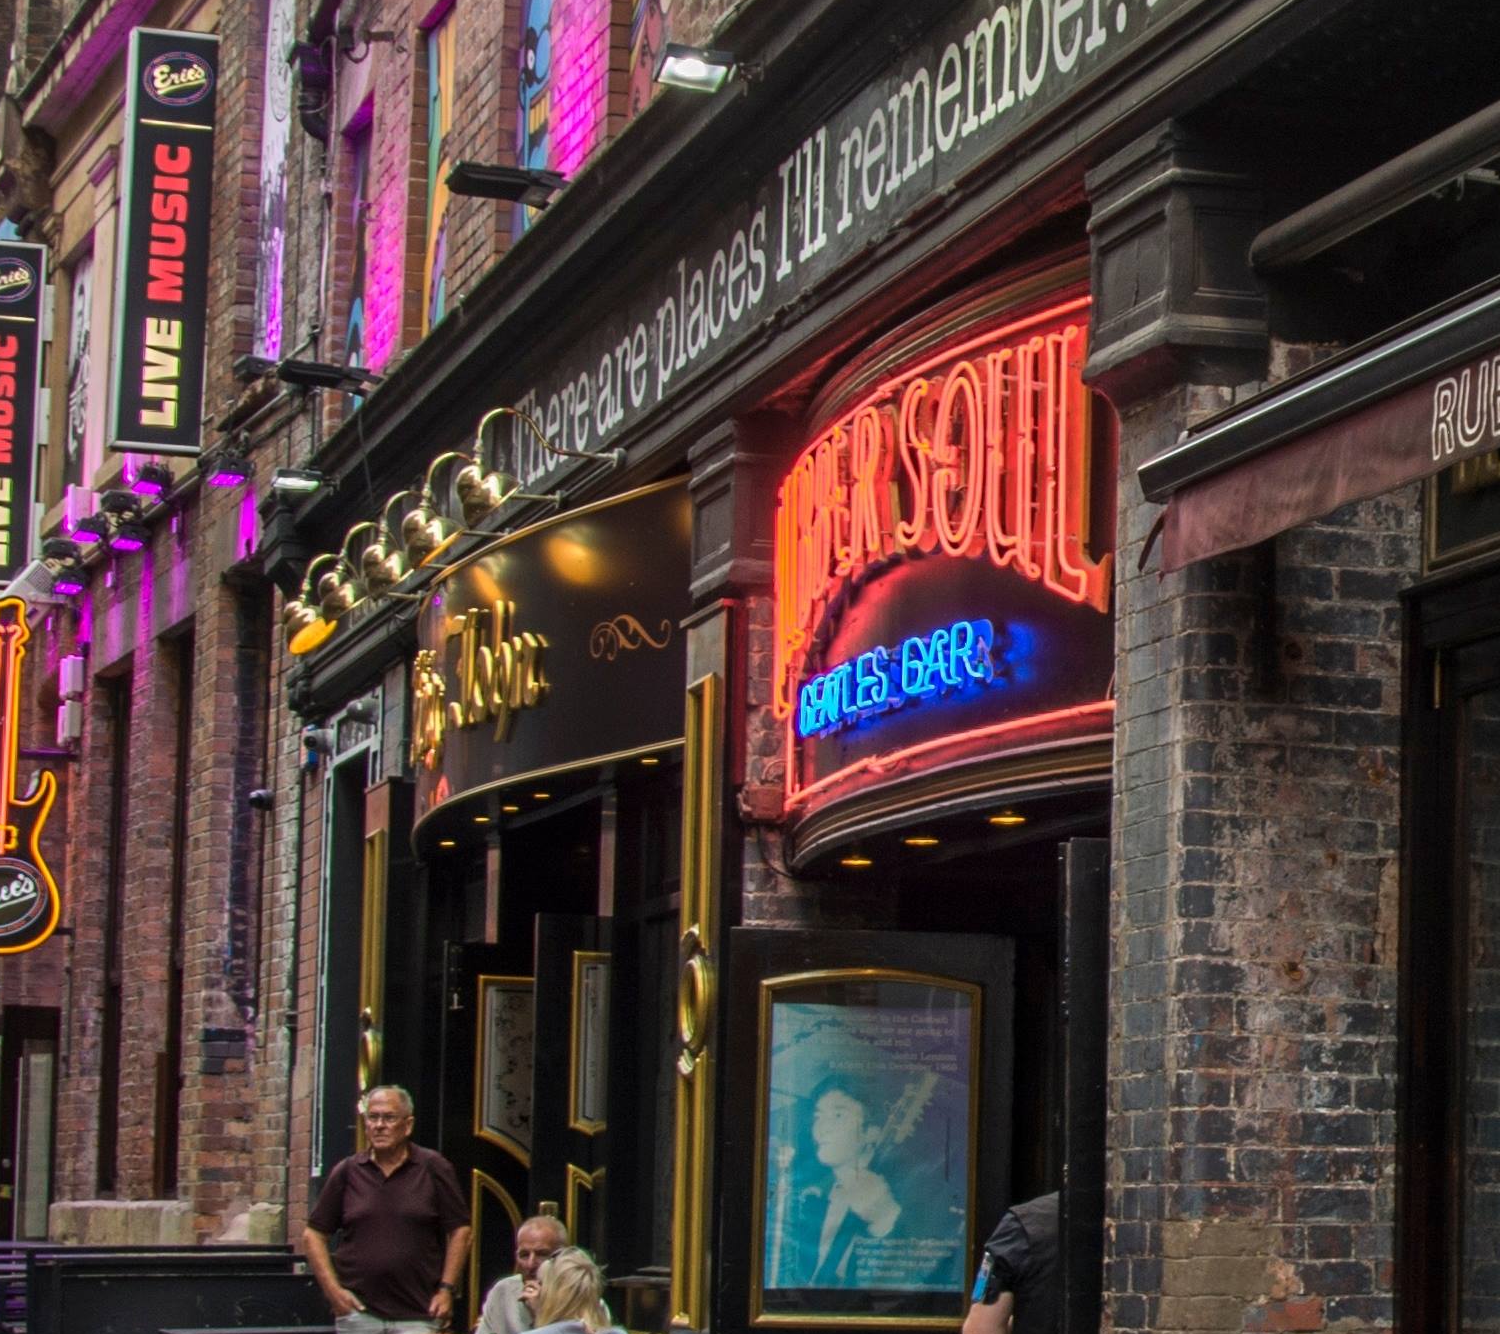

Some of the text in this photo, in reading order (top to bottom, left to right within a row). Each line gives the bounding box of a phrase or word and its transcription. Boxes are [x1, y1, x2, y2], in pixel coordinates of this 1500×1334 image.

[152, 63, 205, 92] Eric's
[140, 143, 192, 428] LIVE MUSIC
[512, 372, 589, 487] There
[597, 323, 648, 437] are
[657, 206, 767, 399] places
[776, 126, 828, 282] I'll
[897, 324, 1106, 607] SOUL
[799, 619, 988, 738] BEATLES BAR
